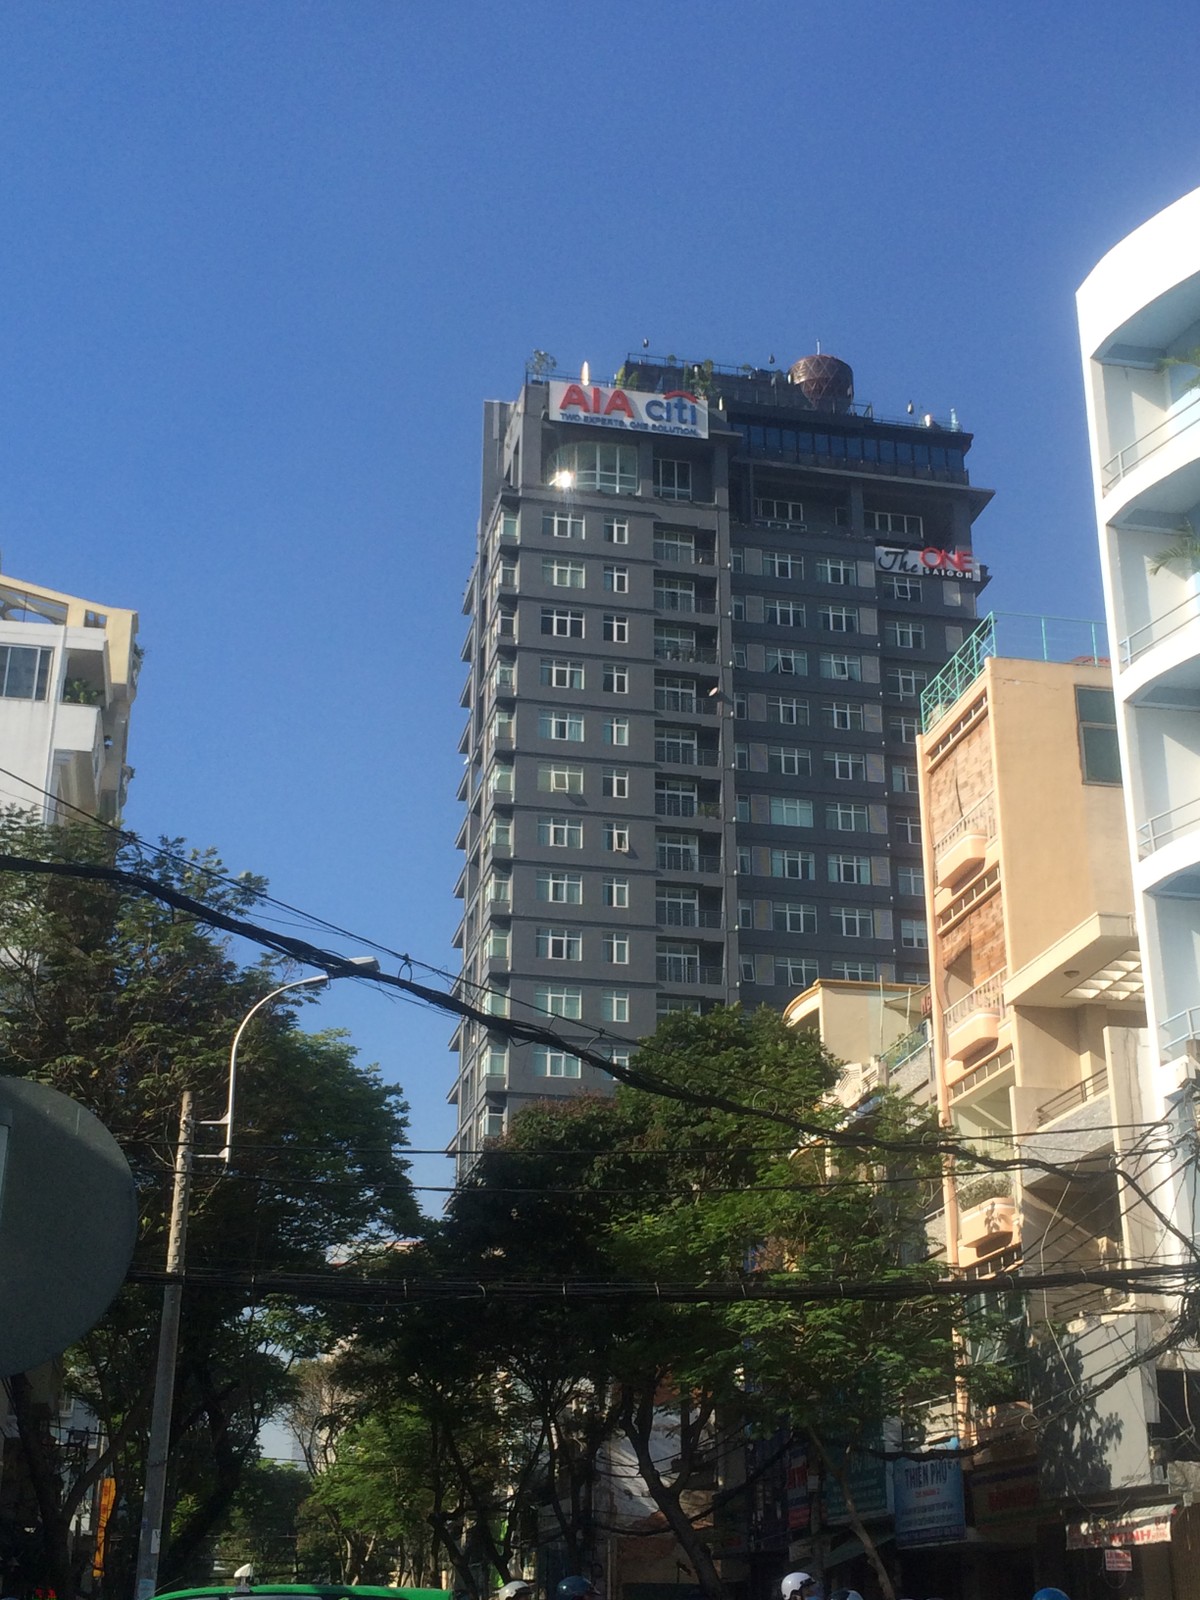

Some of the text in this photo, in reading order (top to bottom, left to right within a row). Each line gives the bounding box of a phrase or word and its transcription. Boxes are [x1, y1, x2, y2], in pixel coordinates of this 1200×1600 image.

[559, 384, 698, 426] AIA citi
[560, 412, 581, 422] TWO
[630, 421, 649, 430] ONE
[878, 545, 973, 573] The ONE
[924, 567, 972, 579] SAIGON
